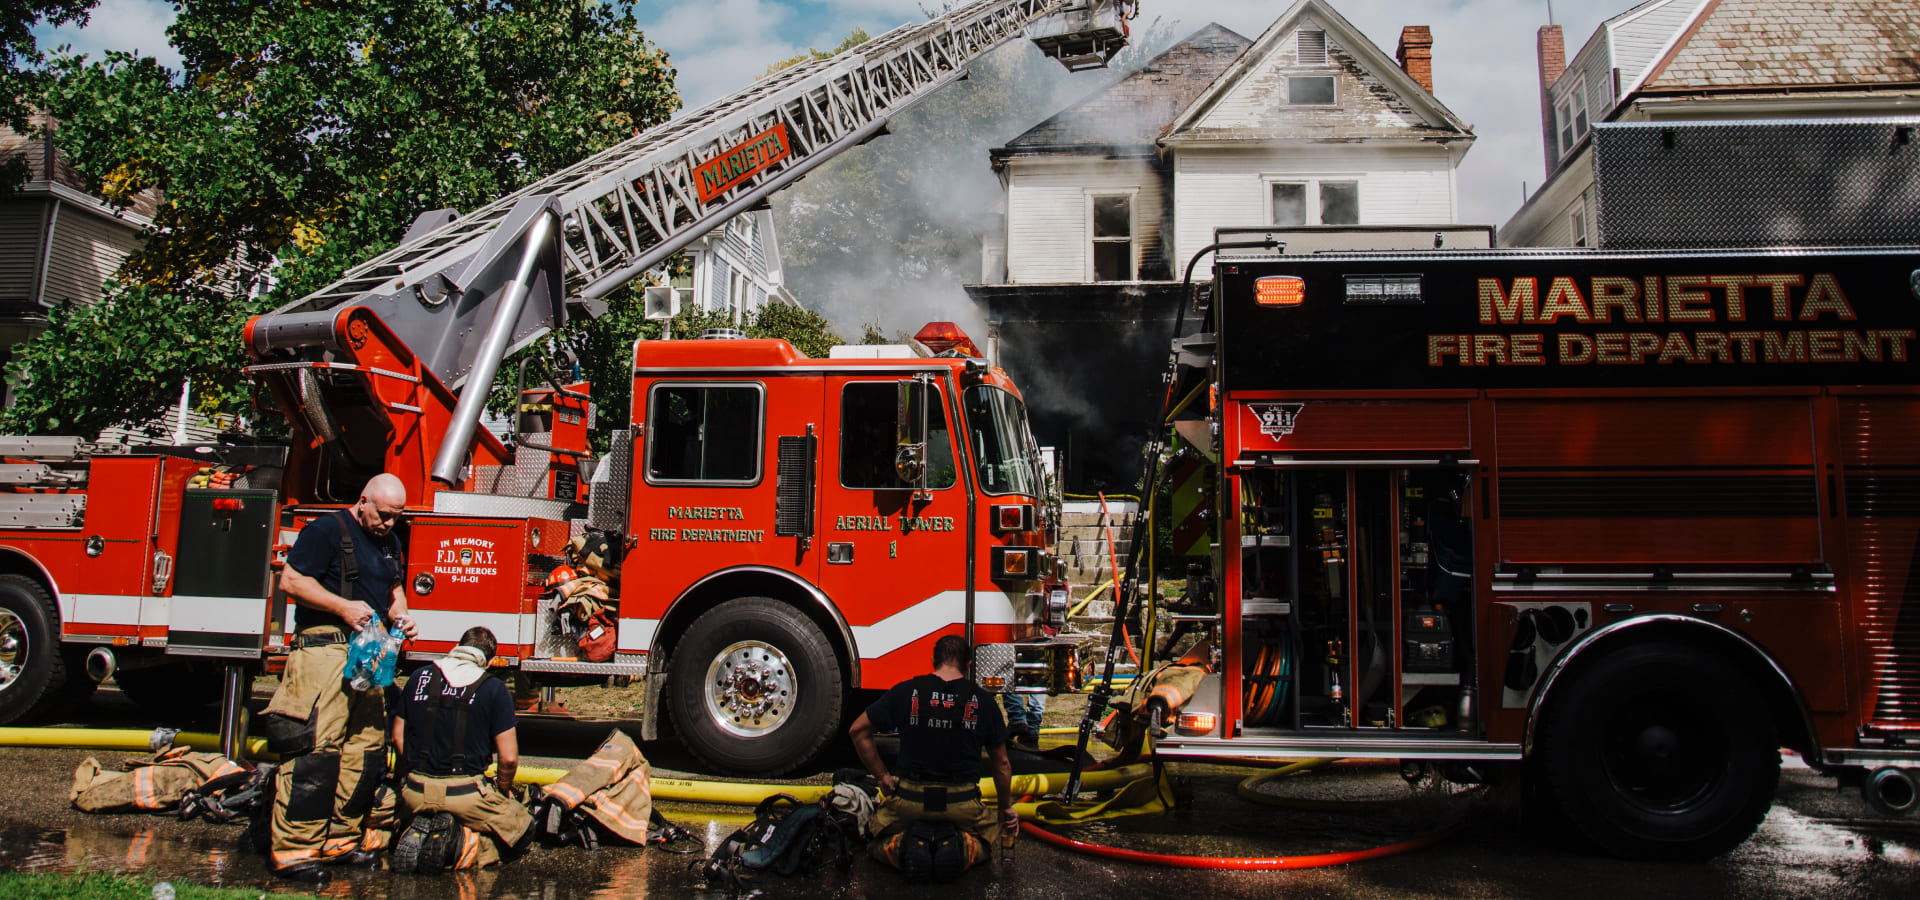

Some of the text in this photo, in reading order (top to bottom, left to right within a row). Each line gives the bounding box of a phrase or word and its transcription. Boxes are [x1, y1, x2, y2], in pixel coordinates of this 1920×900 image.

[701, 132, 785, 195] MARIETTA
[1477, 274, 1858, 324] MARIETTA
[1428, 330, 1915, 367] FIRE DEPARTMENT
[668, 506, 744, 520] MARIETTA
[834, 515, 954, 532] AERIAL TOWER
[440, 537, 495, 549] IN MEMORY
[649, 528, 764, 543] FIRE DEPARTMENT
[889, 539, 897, 558] 1
[434, 566, 497, 575] FALLEN HEROES
[451, 575, 479, 583] 9-11-01
